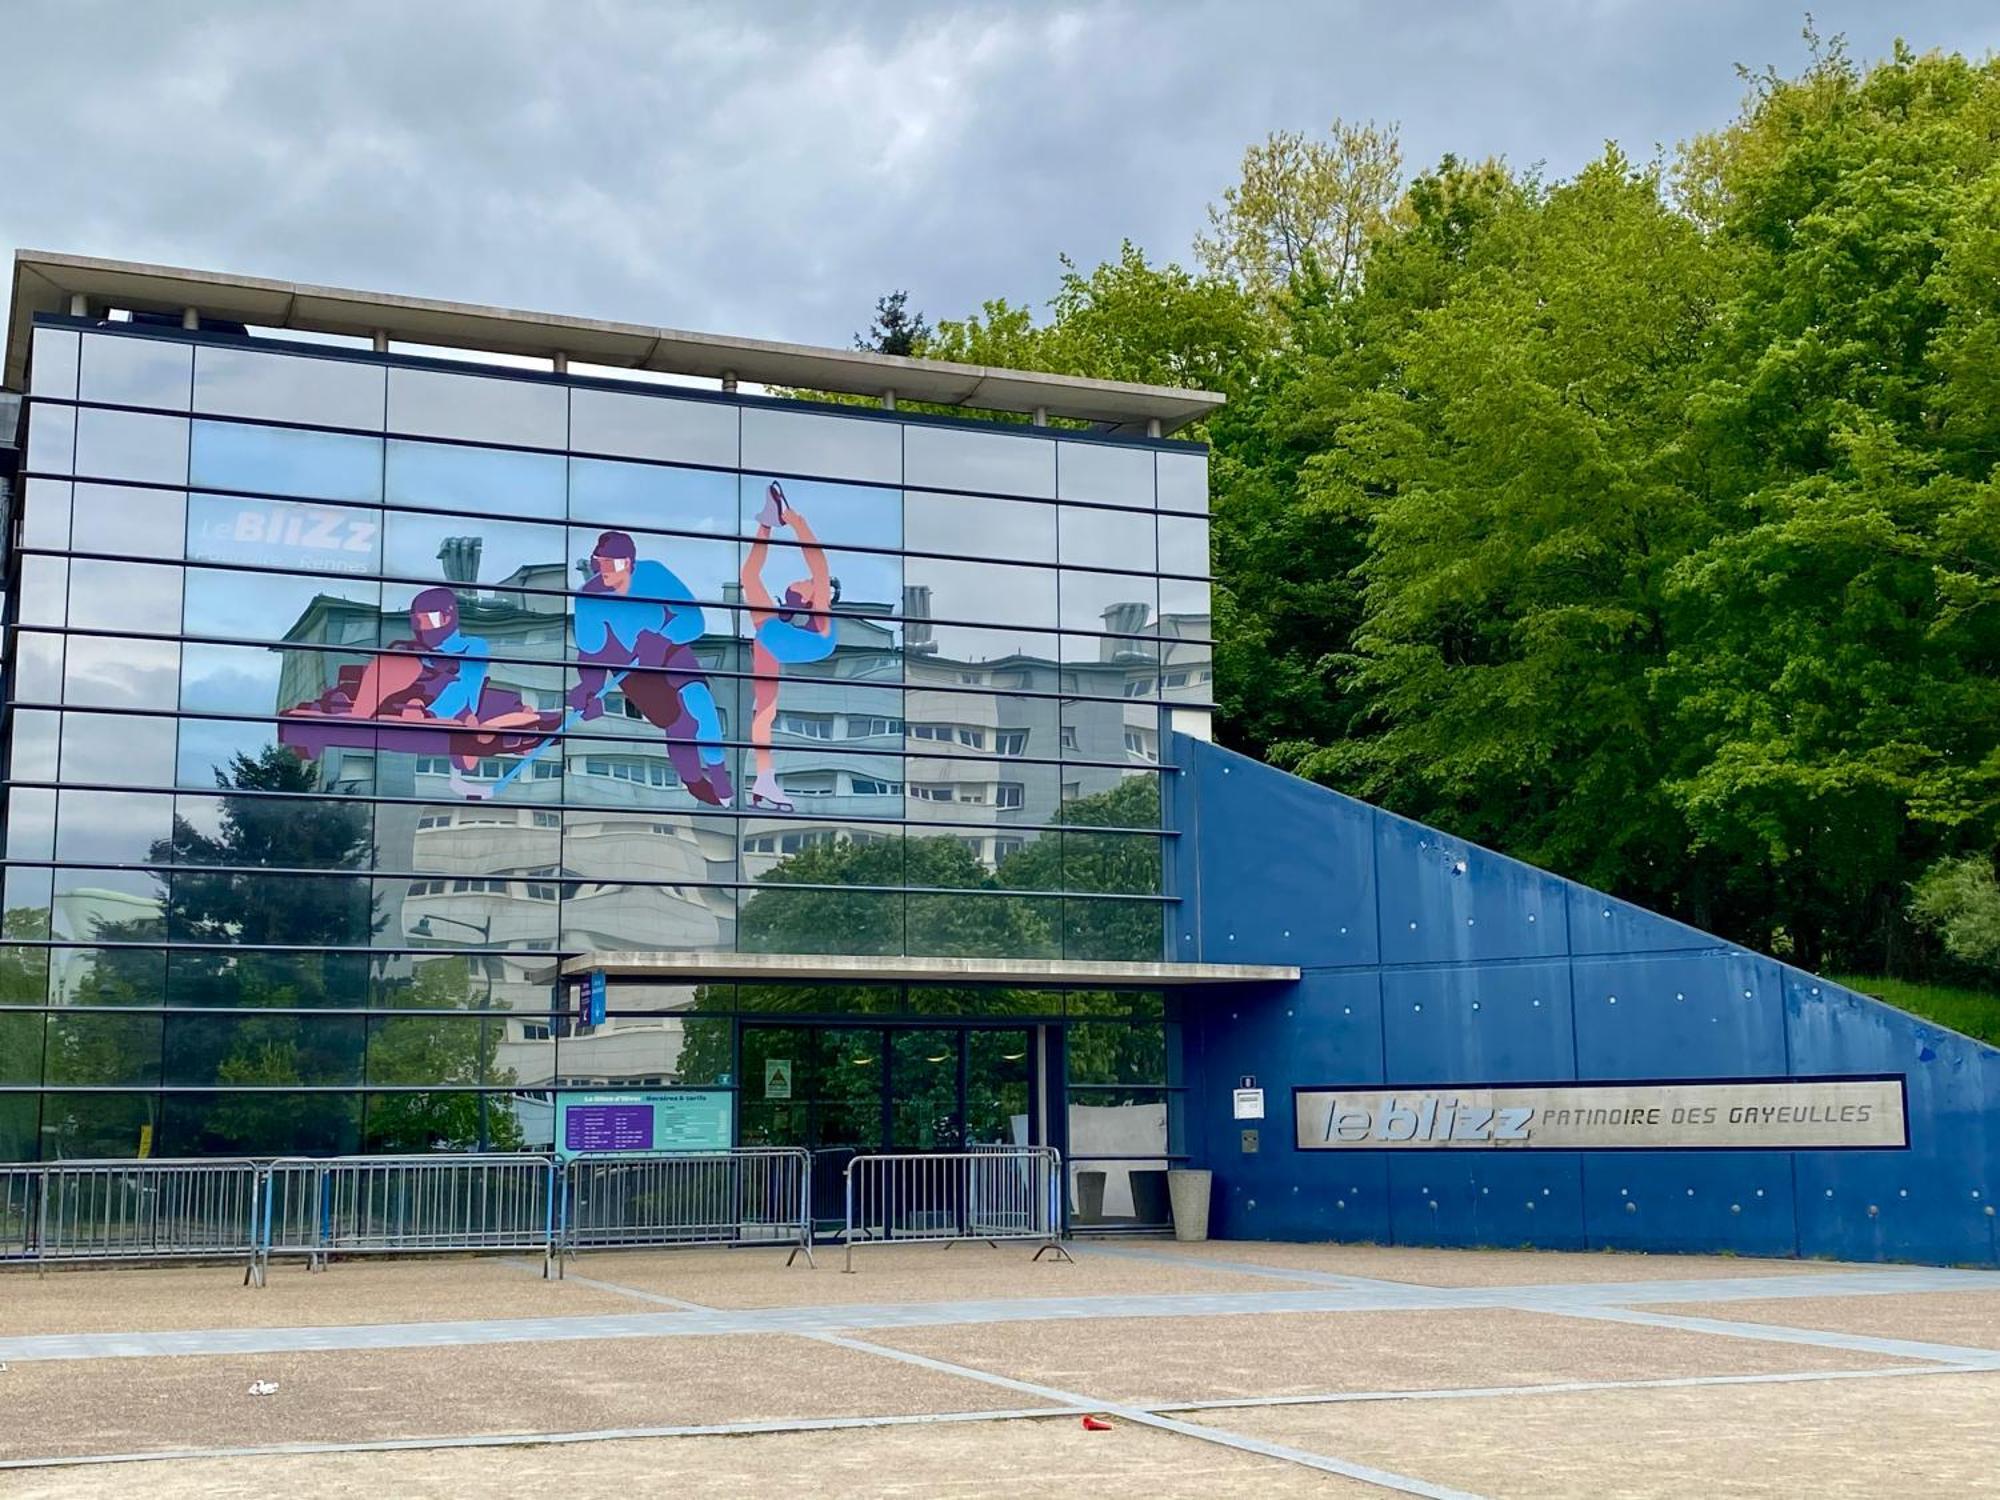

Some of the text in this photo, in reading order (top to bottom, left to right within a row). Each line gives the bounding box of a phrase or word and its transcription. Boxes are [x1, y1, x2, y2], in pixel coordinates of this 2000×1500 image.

[1542, 1108, 1661, 1126] PATINOIRE
[1671, 1107, 1718, 1124] DES
[1728, 1105, 1872, 1124] GAYEULLES
